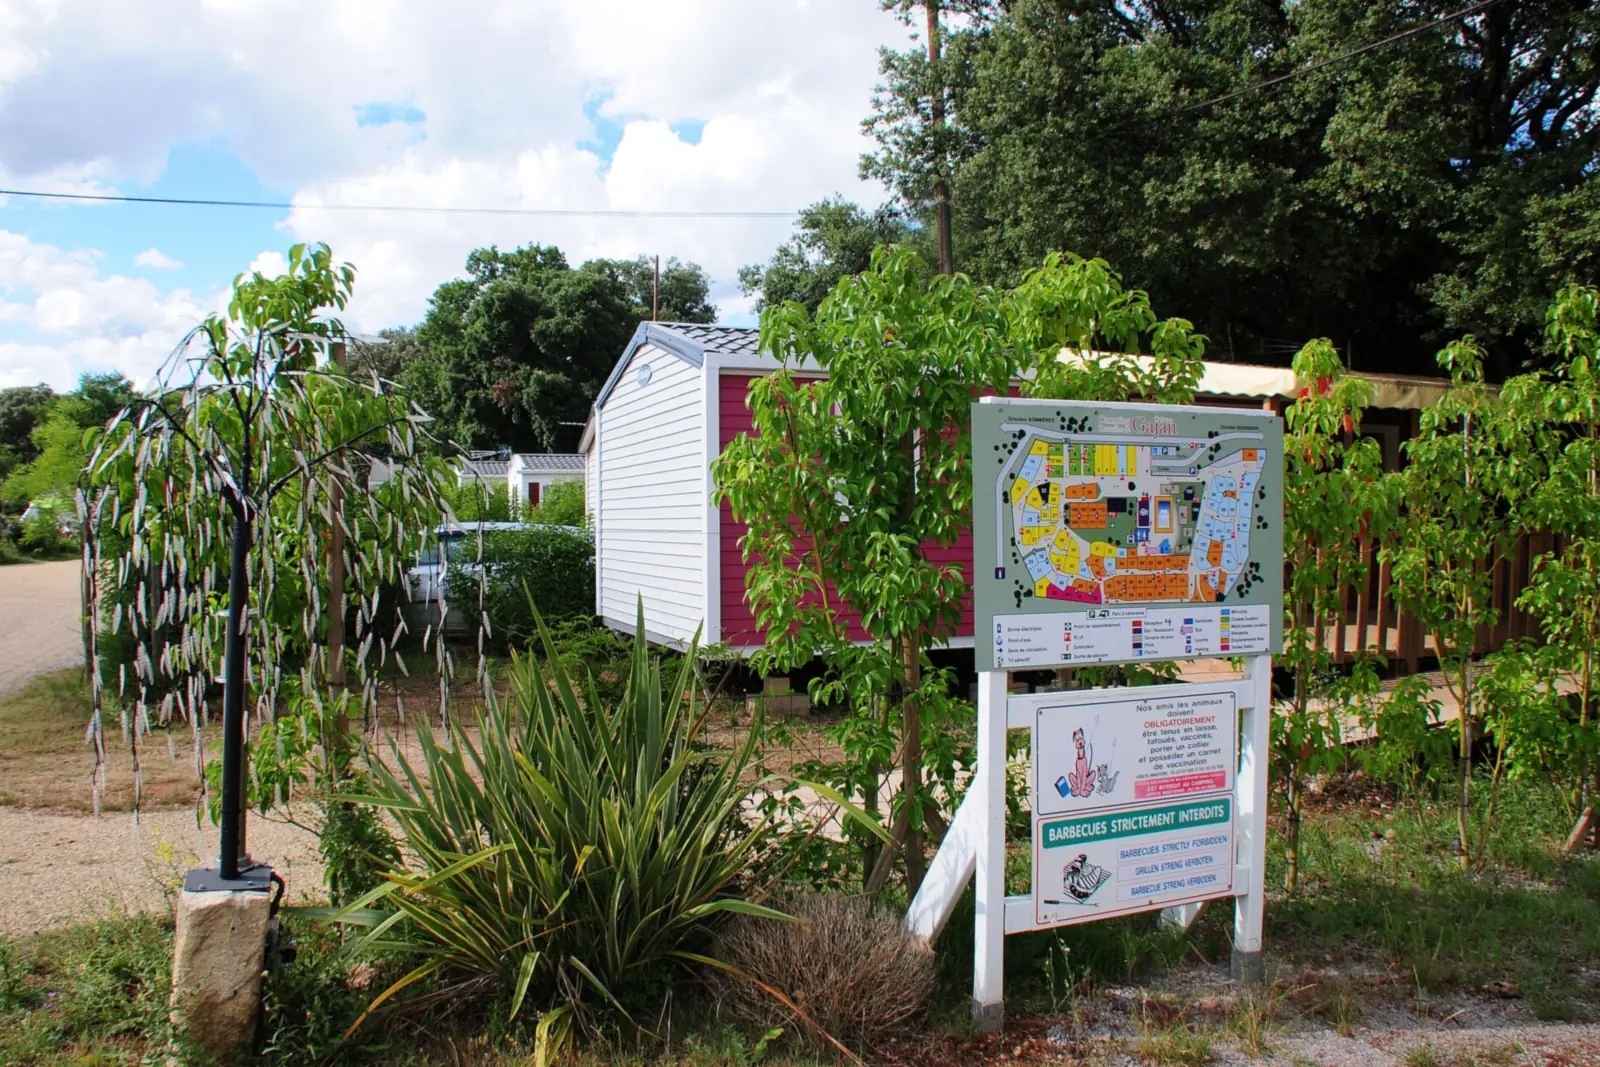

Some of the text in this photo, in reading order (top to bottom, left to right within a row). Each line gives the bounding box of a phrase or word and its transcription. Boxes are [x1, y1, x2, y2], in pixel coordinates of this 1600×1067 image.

[1132, 416, 1176, 438] Gajan
[1167, 709, 1194, 717] doivent
[1144, 716, 1216, 728] OBLIGATOIREMENT
[1149, 752, 1184, 763] posséder
[1198, 748, 1221, 756] carnet
[1150, 746, 1172, 754] porter
[1167, 758, 1207, 768] vaccination
[1049, 805, 1224, 842] BARBECUES STRICTEMENT INTERDITS
[1120, 835, 1227, 859] BARBECUES STRICTLY FORBIDDEN
[1135, 856, 1213, 876] GRILLEN STRENG VERBOTEN
[1131, 874, 1216, 896] BARBECUE STRENG VERBODEN
